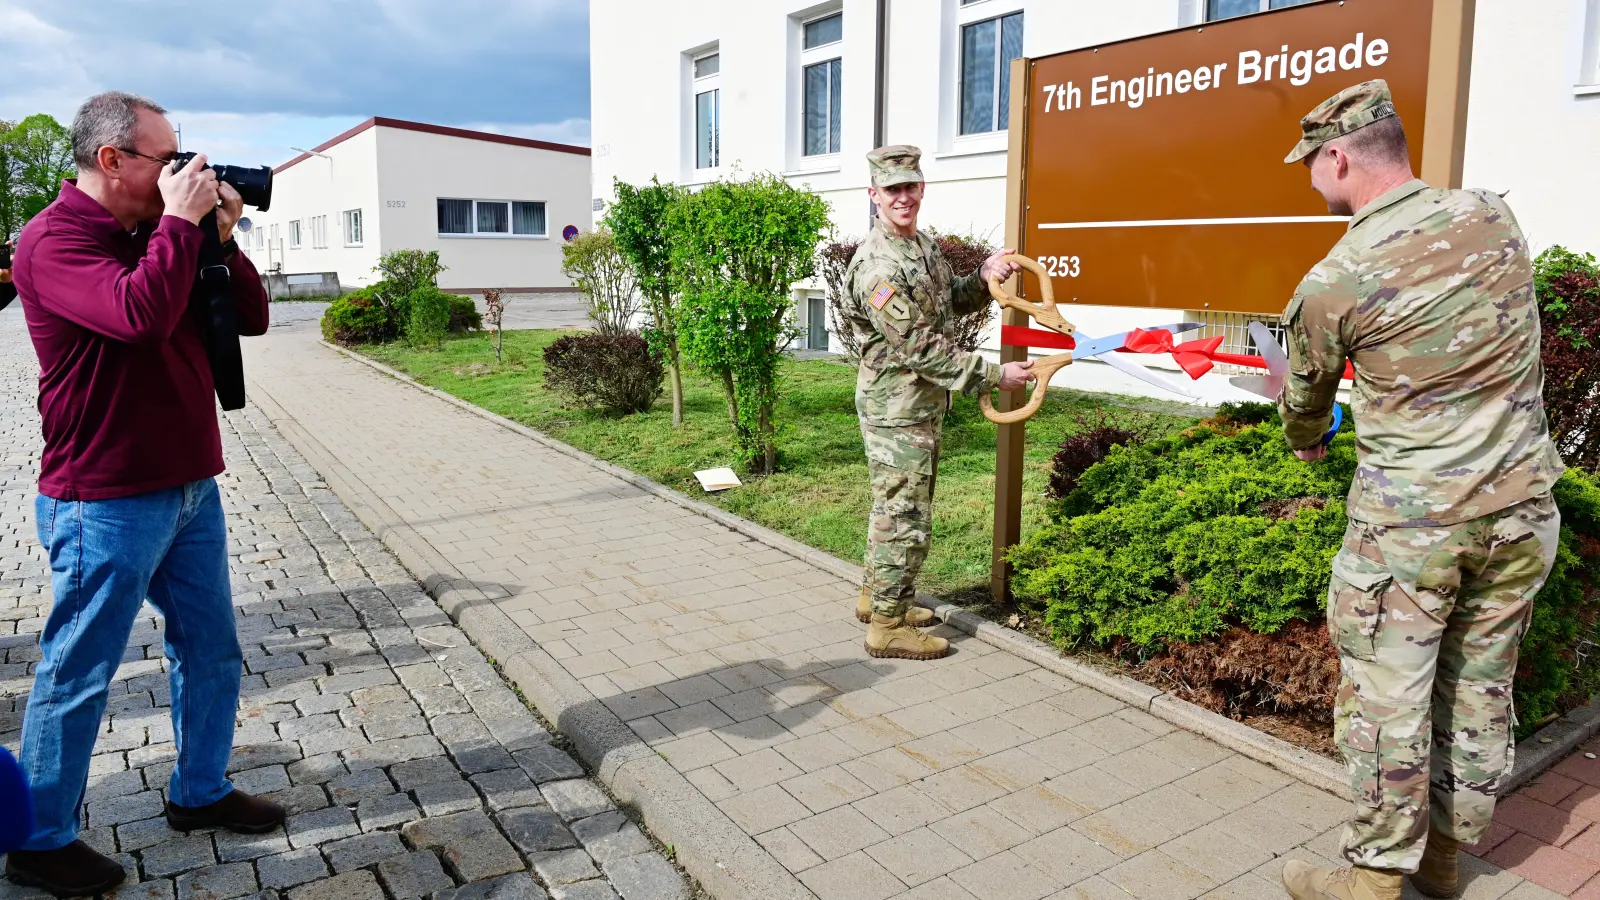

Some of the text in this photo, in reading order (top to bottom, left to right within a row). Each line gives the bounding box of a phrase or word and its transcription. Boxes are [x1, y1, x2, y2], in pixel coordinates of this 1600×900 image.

[1043, 32, 1389, 113] 7th Engineer Brigade
[386, 200, 407, 208] 5252
[1037, 255, 1080, 278] 5253
